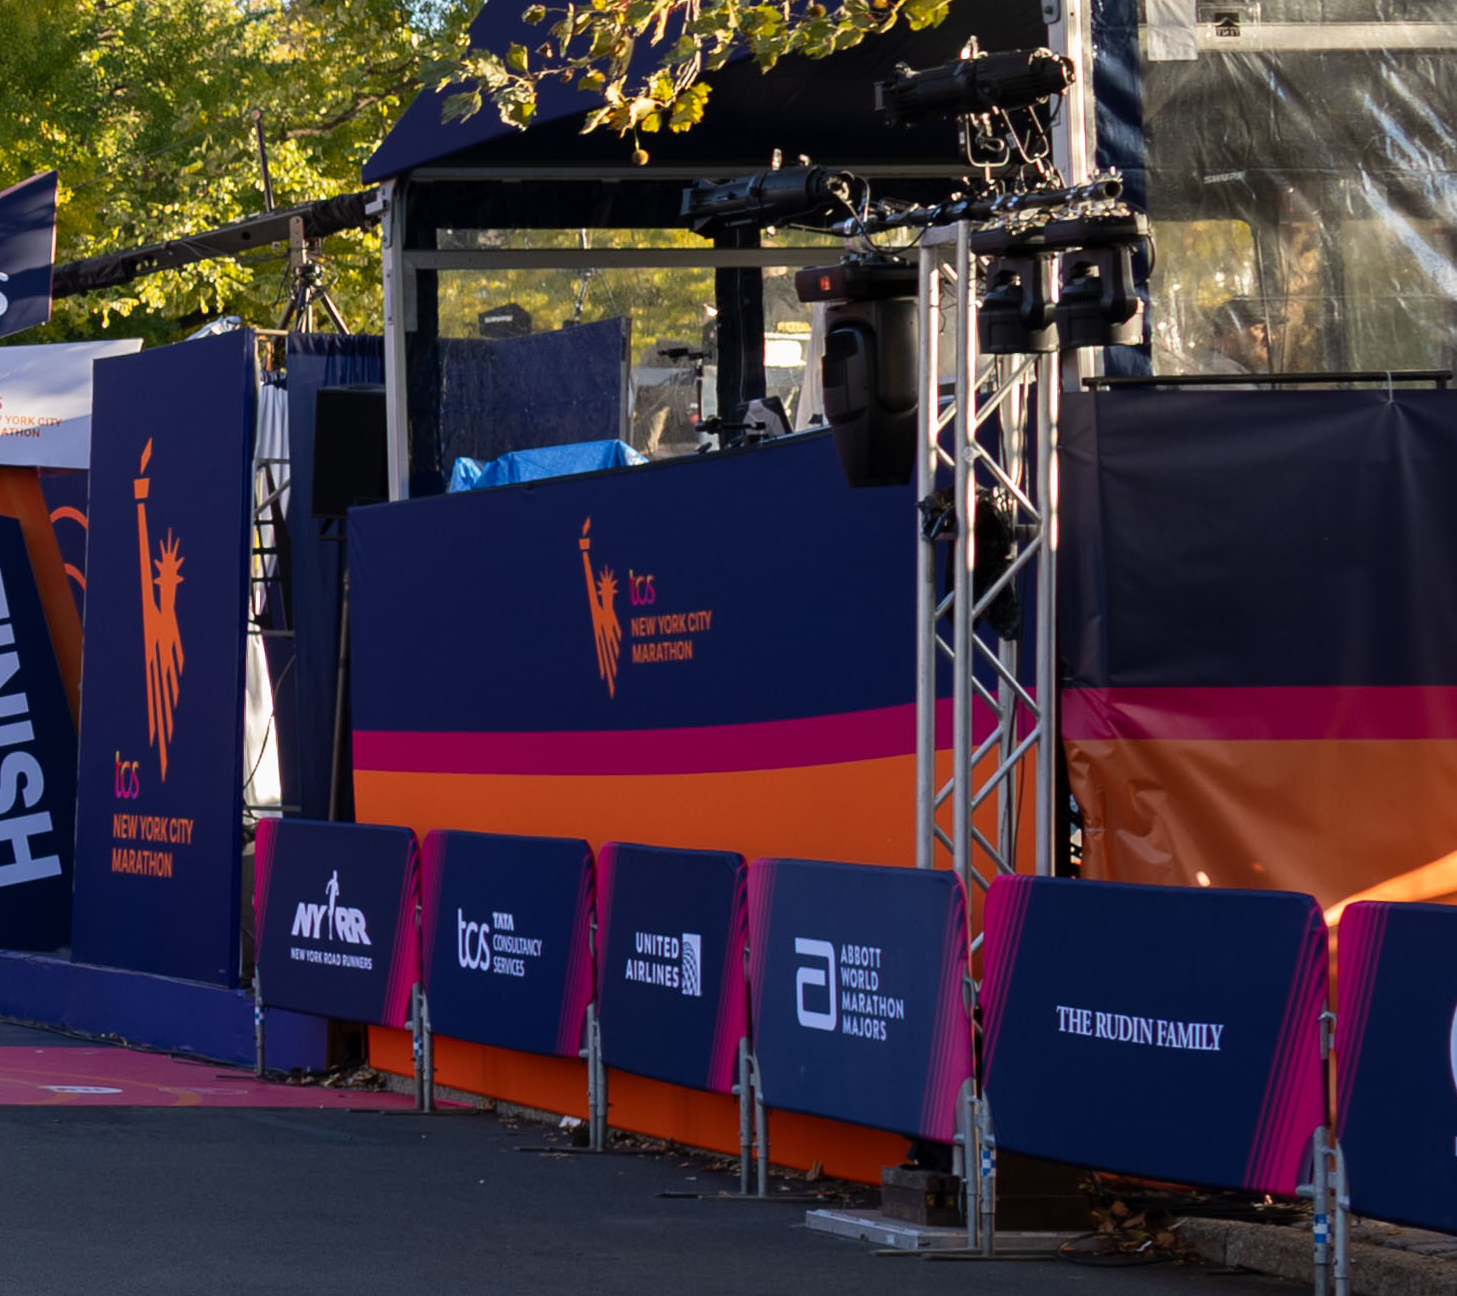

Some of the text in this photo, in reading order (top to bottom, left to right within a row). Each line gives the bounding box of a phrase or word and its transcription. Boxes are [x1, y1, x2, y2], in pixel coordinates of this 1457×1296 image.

[5, 416, 35, 425] YORK
[38, 417, 62, 427] CITY
[629, 569, 656, 606] tcs
[631, 610, 712, 637] NEW YORK CITY
[632, 641, 693, 663] MARATHON
[115, 750, 140, 800] tcs
[112, 814, 194, 844] NEW YORK CITY
[111, 848, 173, 878] MARATHON
[291, 902, 372, 945] NYRR
[493, 911, 514, 930] TATA
[457, 908, 491, 972] tcs
[493, 936, 542, 957] CONSULTANCY
[635, 931, 679, 959] UNITED
[290, 947, 373, 970] NEW YORK ROAD RUNNERS
[493, 958, 525, 977] SERVICES
[840, 944, 882, 969] ABBOTT
[625, 959, 679, 989] AIRLINES
[840, 967, 879, 992] WORLD
[841, 991, 905, 1020] MARATHON
[841, 1017, 887, 1042] MAJORS
[1056, 1005, 1224, 1051] THE RUDIN FAMILY
